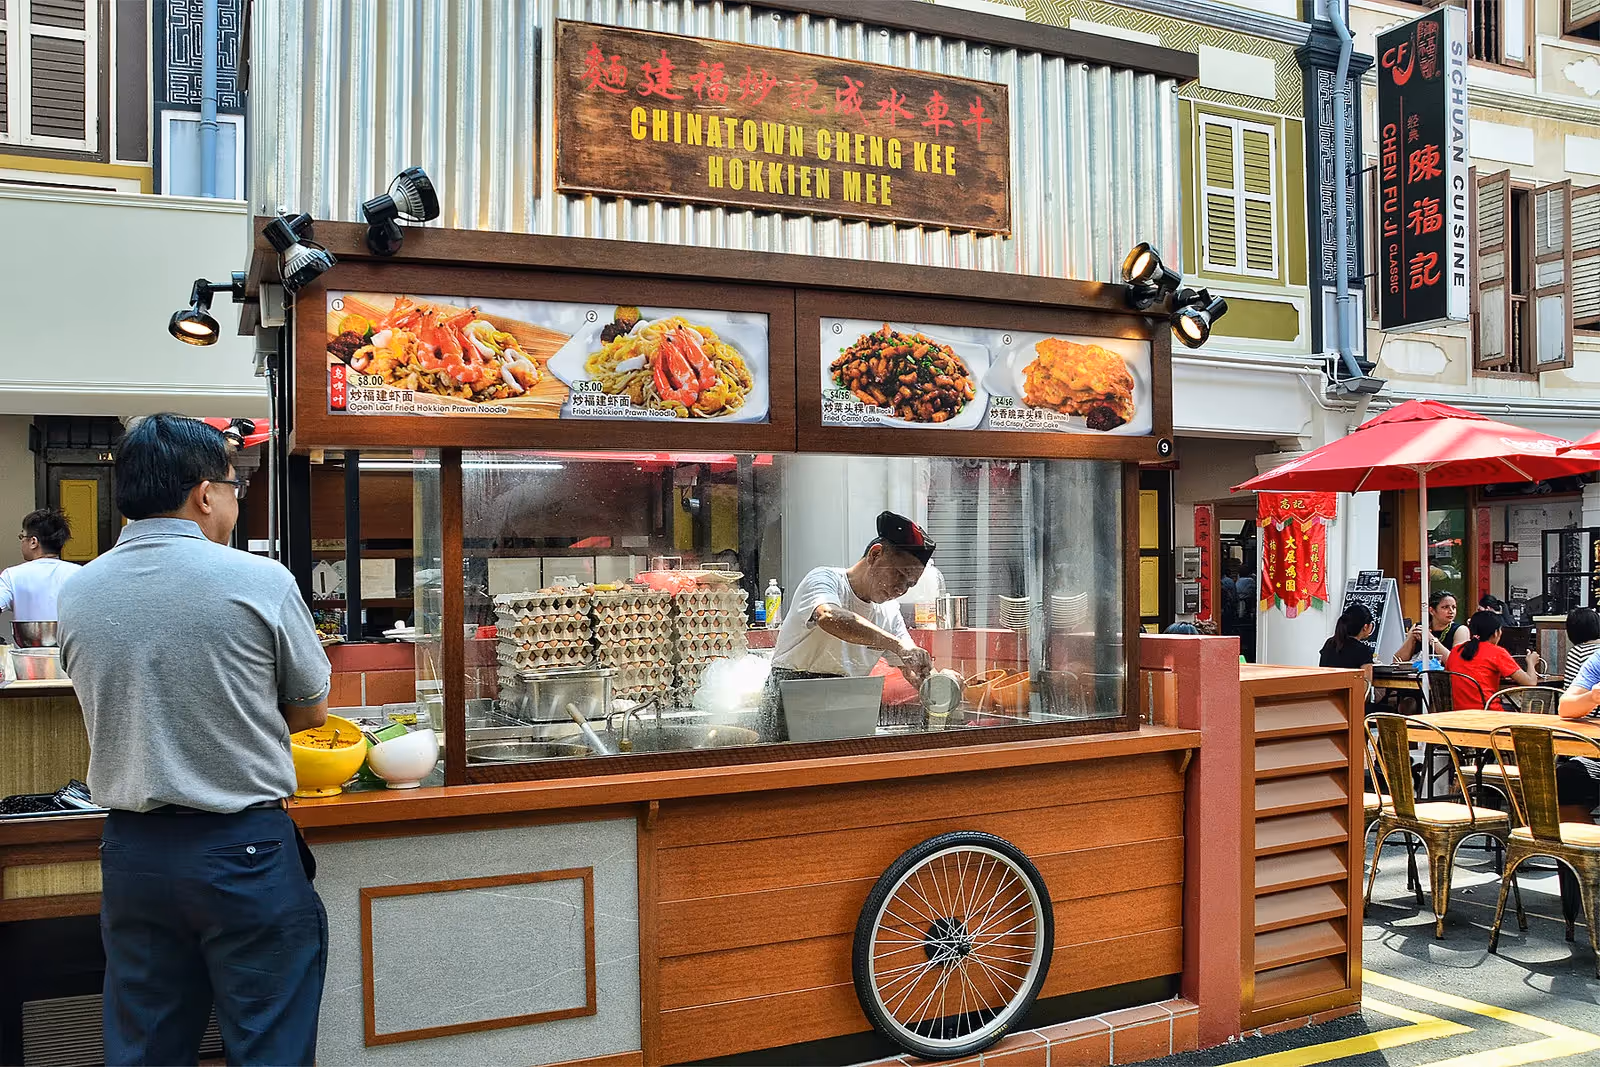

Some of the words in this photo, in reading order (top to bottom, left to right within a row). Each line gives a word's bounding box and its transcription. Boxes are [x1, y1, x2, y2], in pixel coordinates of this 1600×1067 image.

[1451, 40, 1465, 163] SICHUAN
[631, 106, 804, 158] CHINATOWN
[817, 128, 902, 170] CHENG
[913, 141, 957, 176] KEE
[1383, 123, 1397, 181] CHEN
[708, 156, 830, 200] HOKKIEN
[843, 170, 893, 206] MEE
[1384, 185, 1397, 213] FU
[1406, 144, 1442, 290] 陳福記
[1384, 219, 1398, 237] JI
[1453, 175, 1465, 287] CUISINE
[1389, 243, 1399, 294] CLASSIC
[358, 375, 383, 387] $8.00
[579, 382, 602, 392] $5.00
[350, 389, 413, 402] 炒福建虾面
[573, 394, 630, 407] 炒福建虾面
[350, 403, 373, 412] Opeh
[395, 404, 415, 412] Fried
[417, 404, 450, 412] Hokkien
[479, 405, 507, 413] Noodle
[593, 408, 623, 416] Hokkien
[841, 414, 861, 422] Carrot
[1006, 420, 1023, 428] Crispy
[1161, 442, 1169, 453] 9
